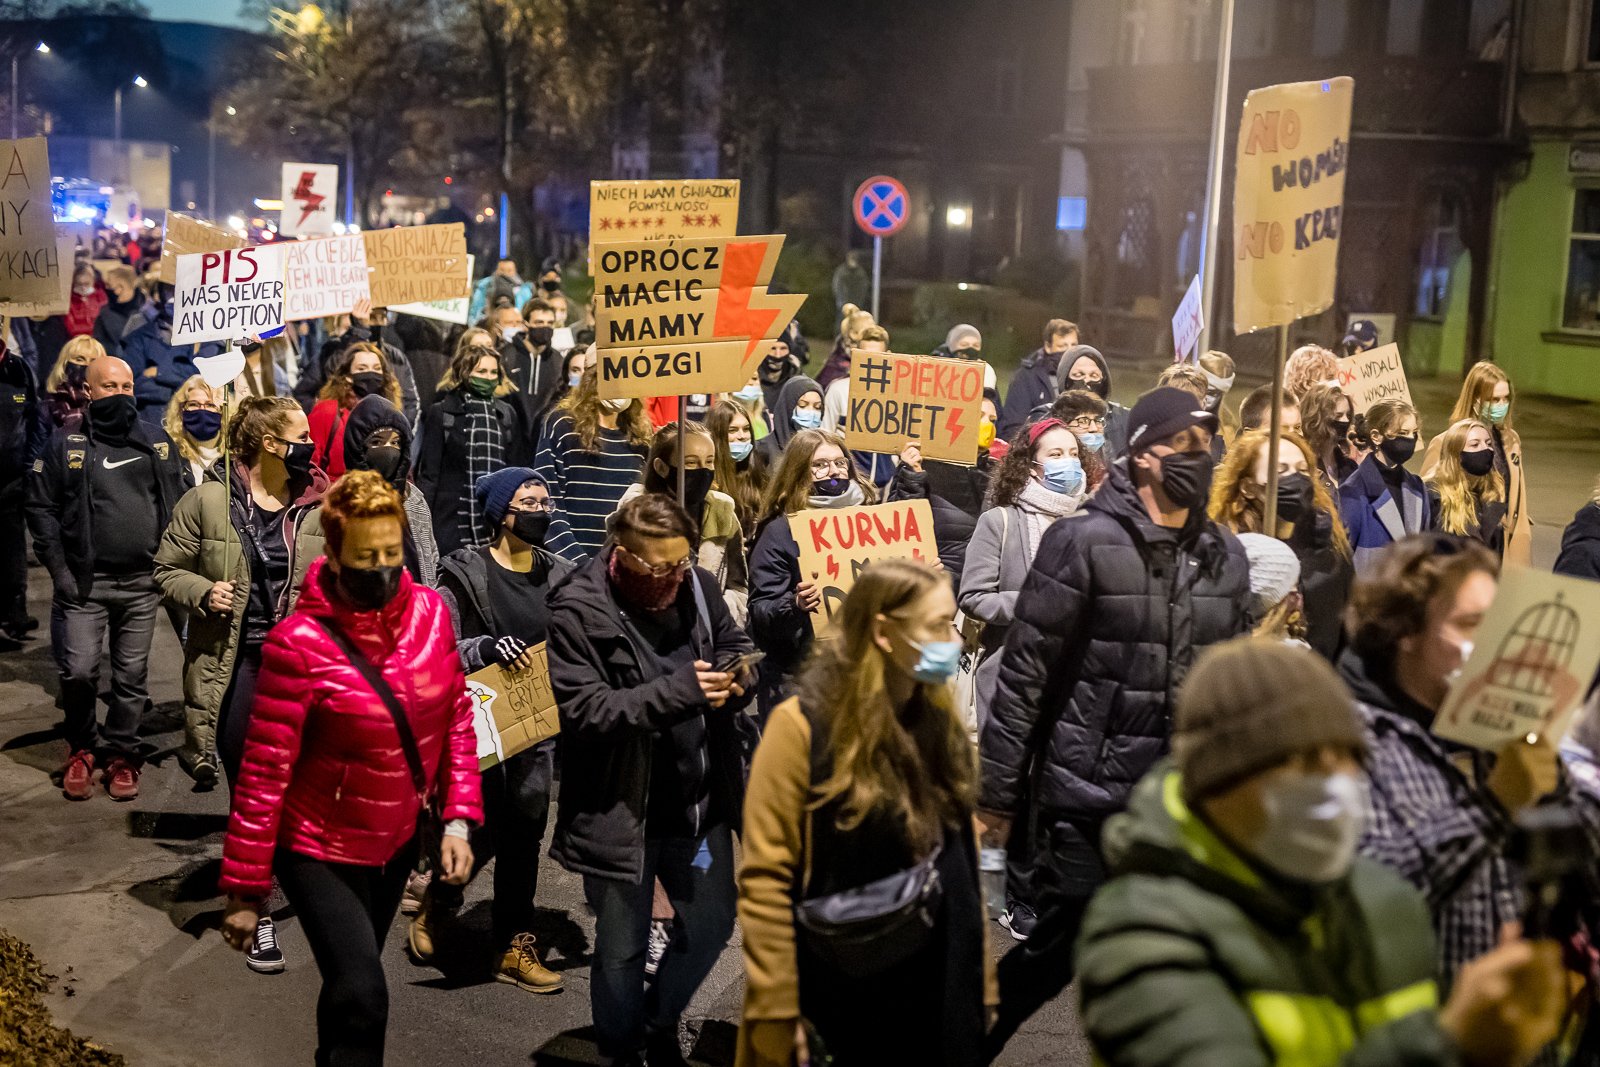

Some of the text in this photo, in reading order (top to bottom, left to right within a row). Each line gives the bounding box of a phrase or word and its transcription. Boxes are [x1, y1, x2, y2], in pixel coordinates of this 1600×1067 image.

[1245, 109, 1301, 155] NO
[644, 186, 675, 199] WAM
[680, 184, 737, 199] GWIAZDKI
[1238, 221, 1285, 260] NO
[201, 248, 258, 285] PIS
[601, 241, 719, 273] OPRÓCZ
[182, 281, 283, 307] WAS NEVER
[604, 279, 702, 308] MACIC
[178, 302, 282, 334] AN OPTION
[610, 313, 704, 342] MAMY
[603, 349, 702, 381] MÓZGI
[859, 358, 980, 402] #PIEKŁO
[1360, 353, 1399, 378] WYDALI
[851, 398, 945, 440] KOBIET
[809, 507, 922, 553] KURWA
[515, 706, 552, 742] TA
